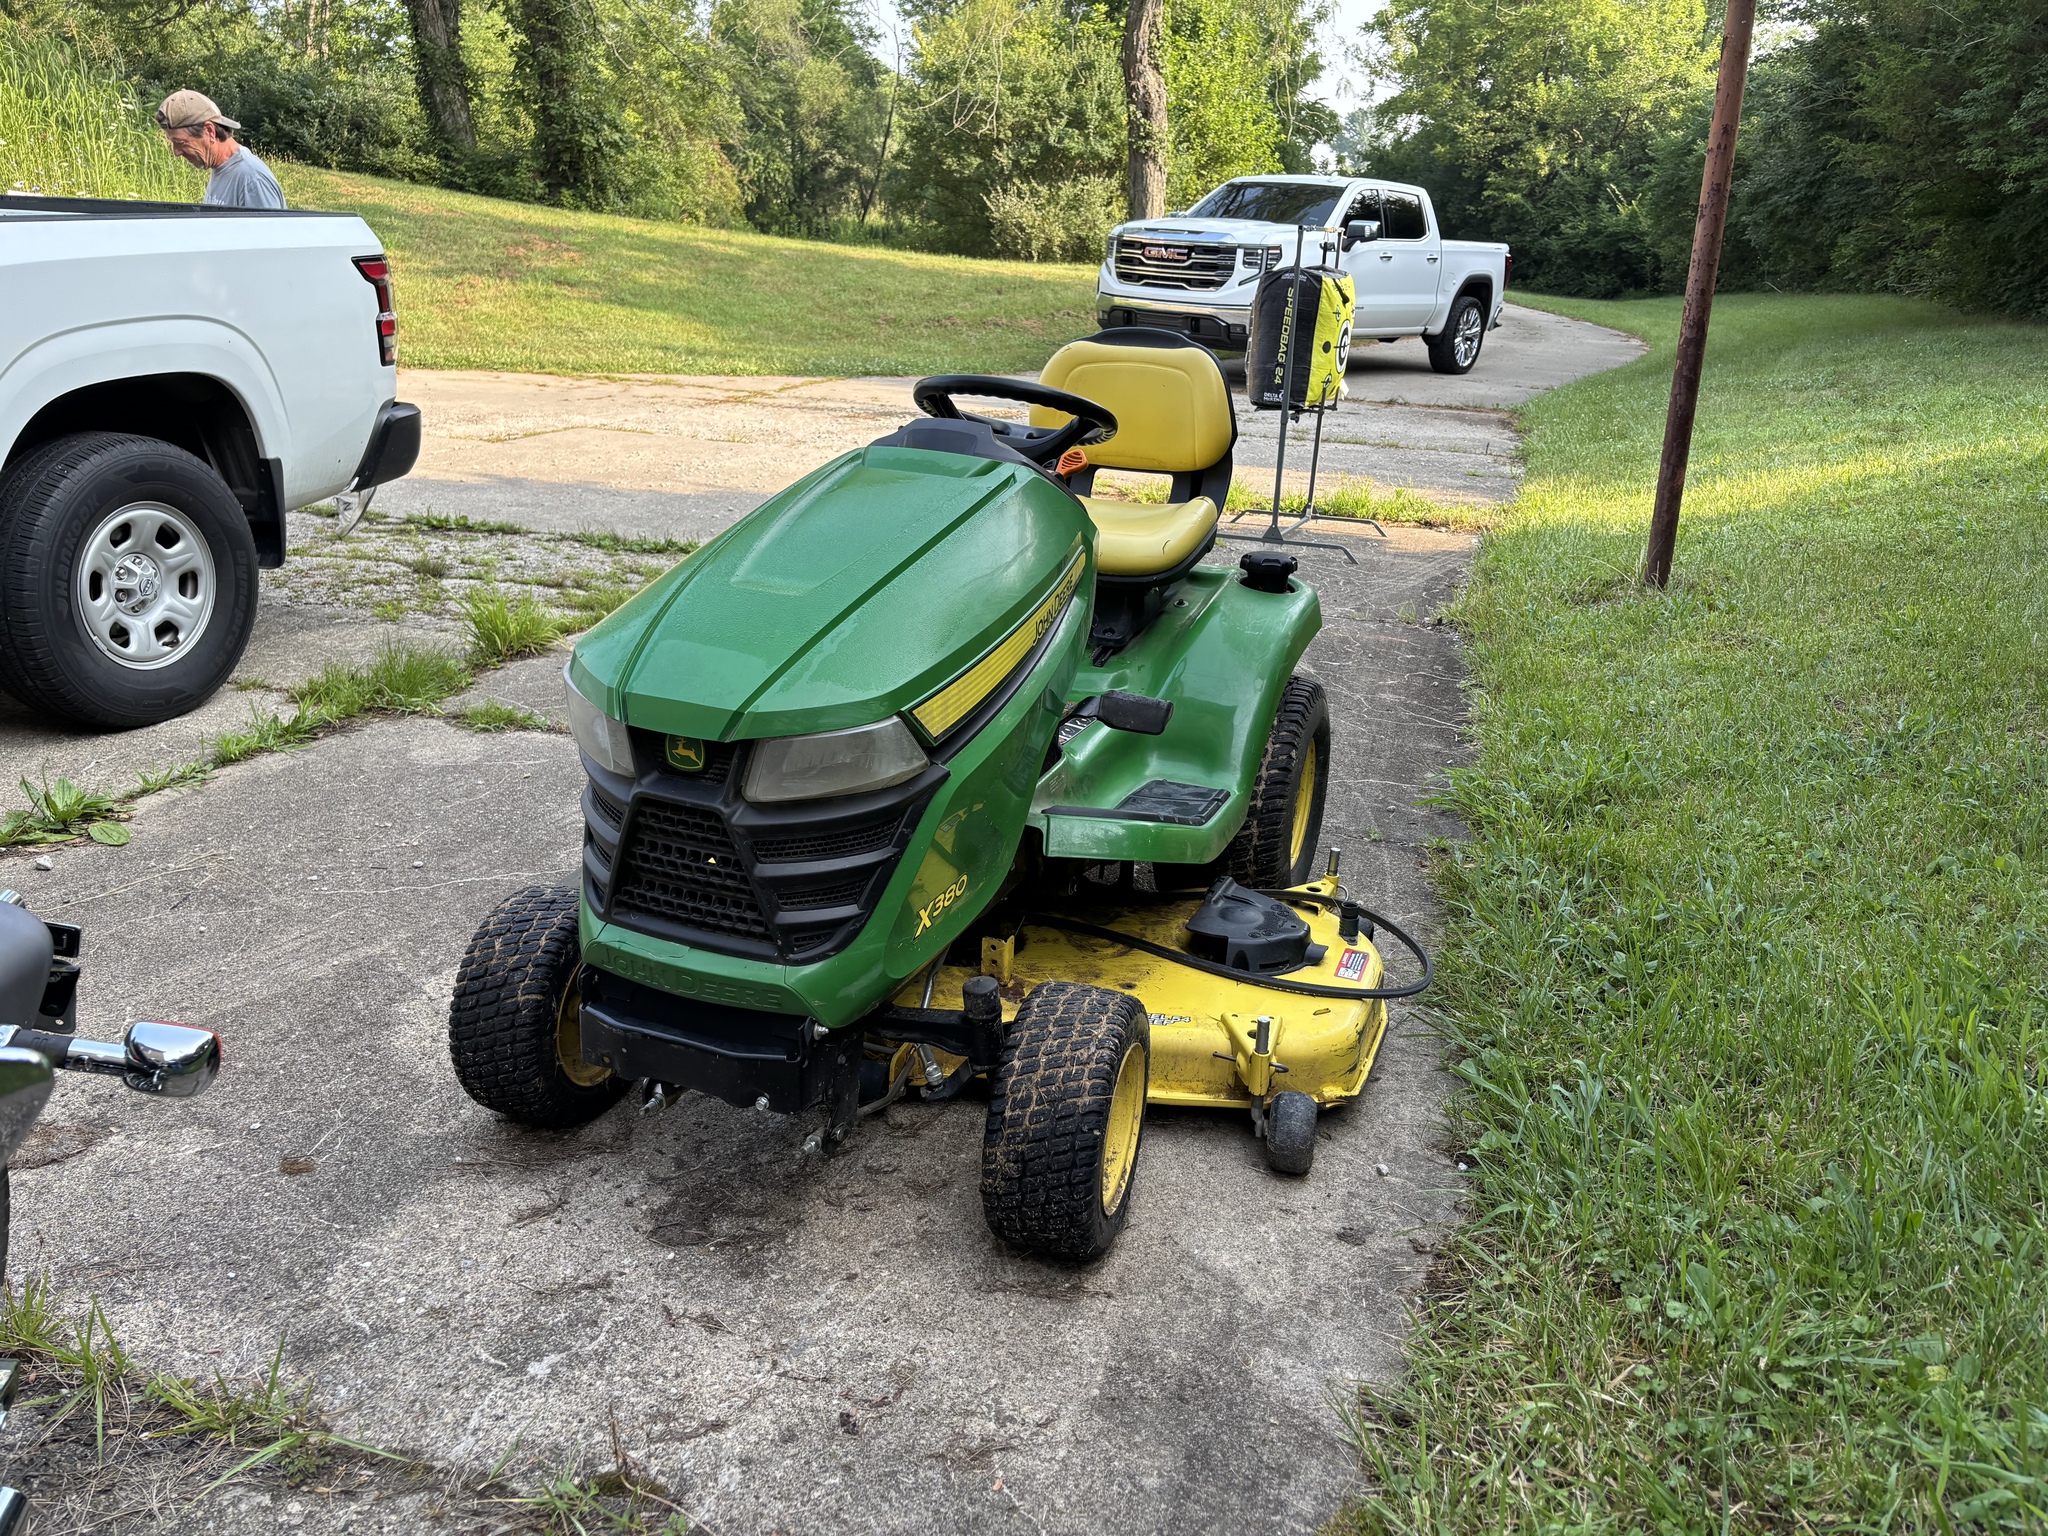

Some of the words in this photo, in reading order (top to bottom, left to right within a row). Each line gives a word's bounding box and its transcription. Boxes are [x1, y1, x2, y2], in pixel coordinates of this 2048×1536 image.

[1144, 246, 1188, 260] GMC
[1277, 287, 1294, 362] SPEEDBAG
[1274, 366, 1283, 385] 24
[1033, 604, 1054, 646] JOHN
[1053, 573, 1074, 616] DEERE
[912, 872, 968, 941] X380
[601, 948, 673, 989] JOHN
[675, 969, 783, 1010] DEERE
